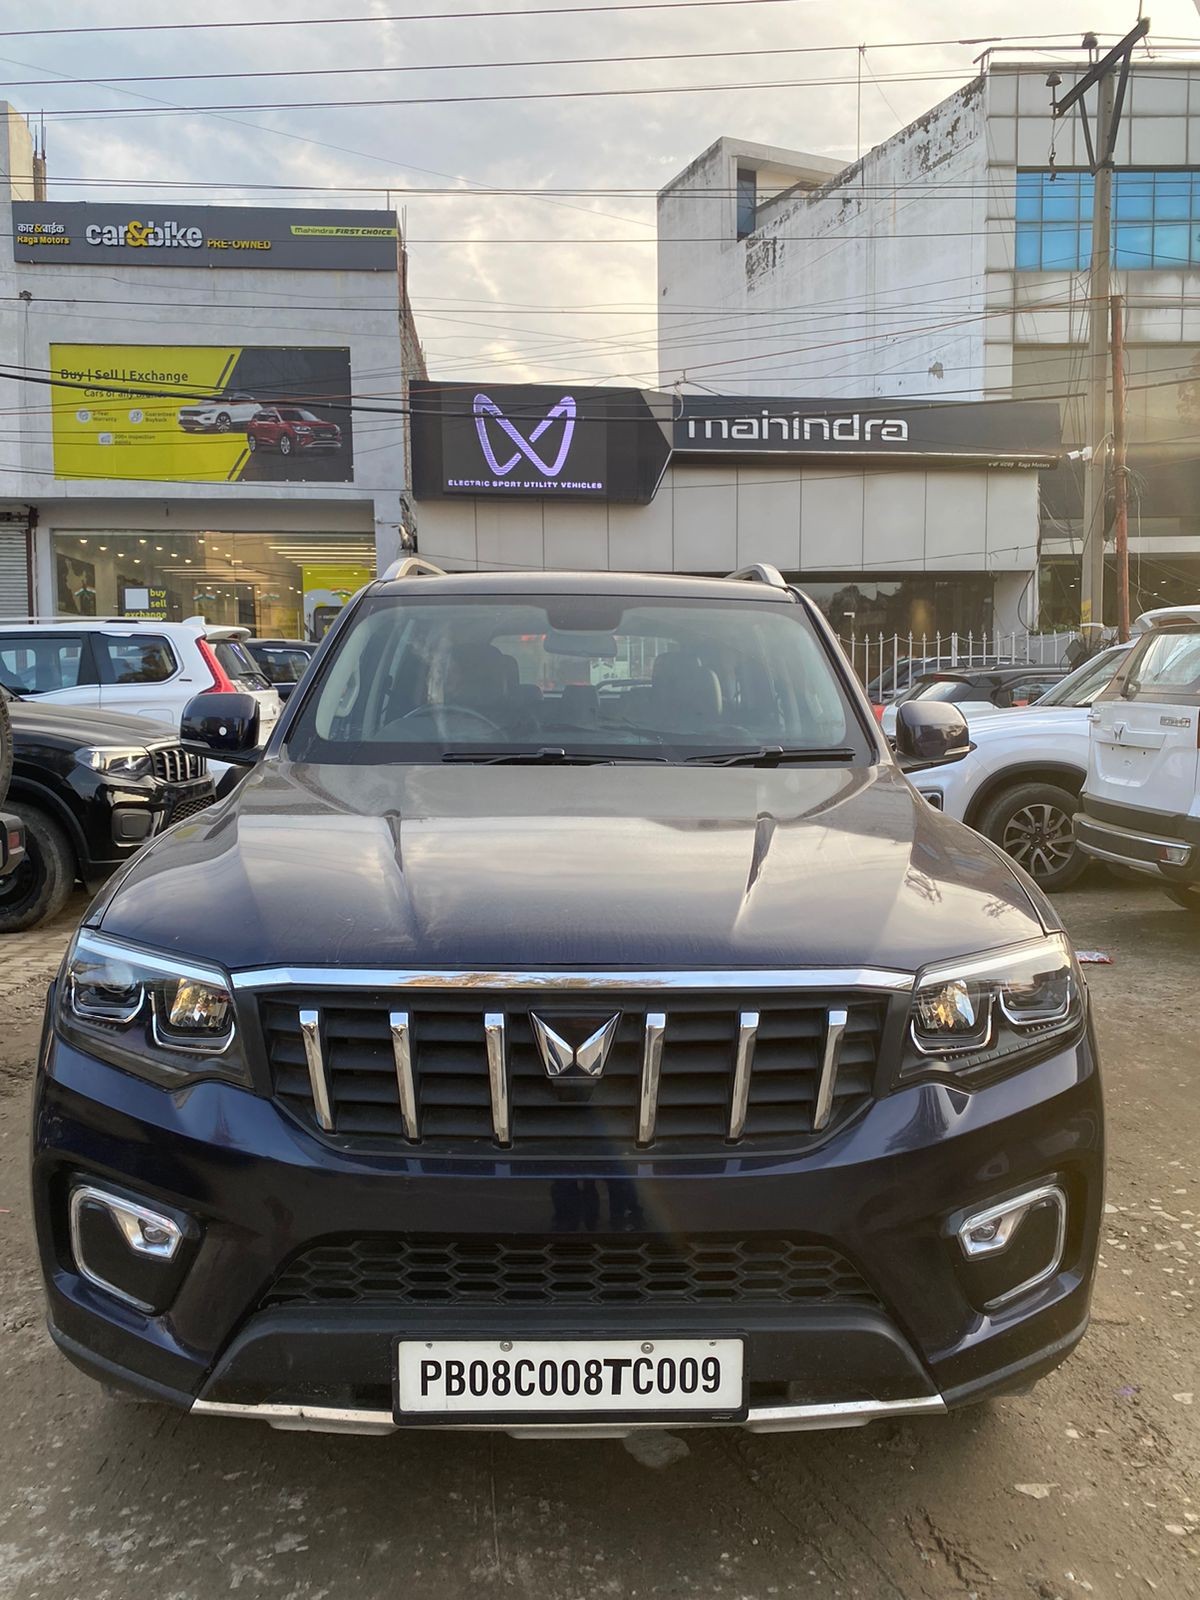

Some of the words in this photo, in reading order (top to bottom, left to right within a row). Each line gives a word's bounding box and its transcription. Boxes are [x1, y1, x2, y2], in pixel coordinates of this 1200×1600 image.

[85, 220, 203, 248] car&bike
[40, 236, 70, 244] Motors
[207, 238, 272, 250] PRE-OWNED
[60, 369, 84, 381] Buy
[95, 369, 118, 380] Sell
[129, 370, 189, 383] Exchange
[84, 389, 104, 398] Cars
[688, 410, 909, 441] mahindra
[448, 479, 490, 487] ELECTRIC
[492, 480, 521, 488] SPORT
[150, 589, 166, 598] buy
[150, 599, 167, 608] sell
[420, 1356, 721, 1397] PB08C008TC009
